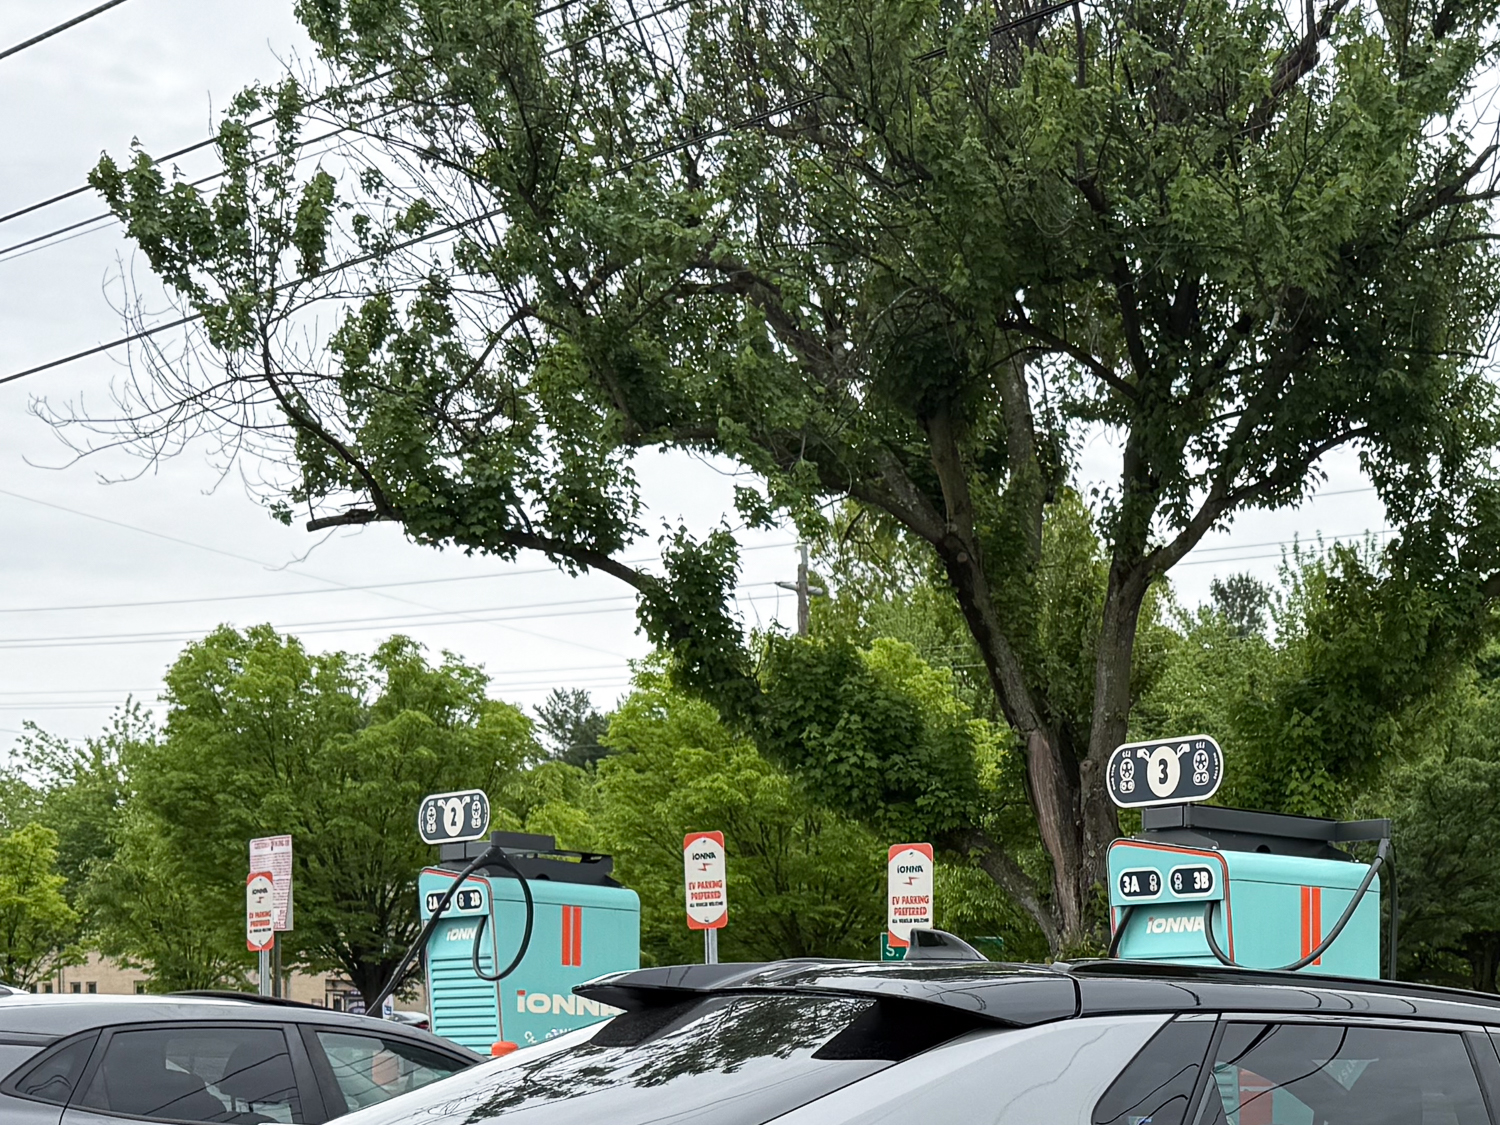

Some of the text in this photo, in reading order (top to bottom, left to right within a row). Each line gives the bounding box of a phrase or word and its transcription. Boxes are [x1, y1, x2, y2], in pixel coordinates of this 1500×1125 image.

[1158, 758, 1168, 785] 3
[450, 807, 457, 827] 2
[697, 880, 722, 889] PARKING
[1122, 875, 1141, 893] 3A
[1193, 871, 1210, 889] 3B
[902, 895, 929, 905] PARKING
[894, 906, 927, 916] PREFERRED
